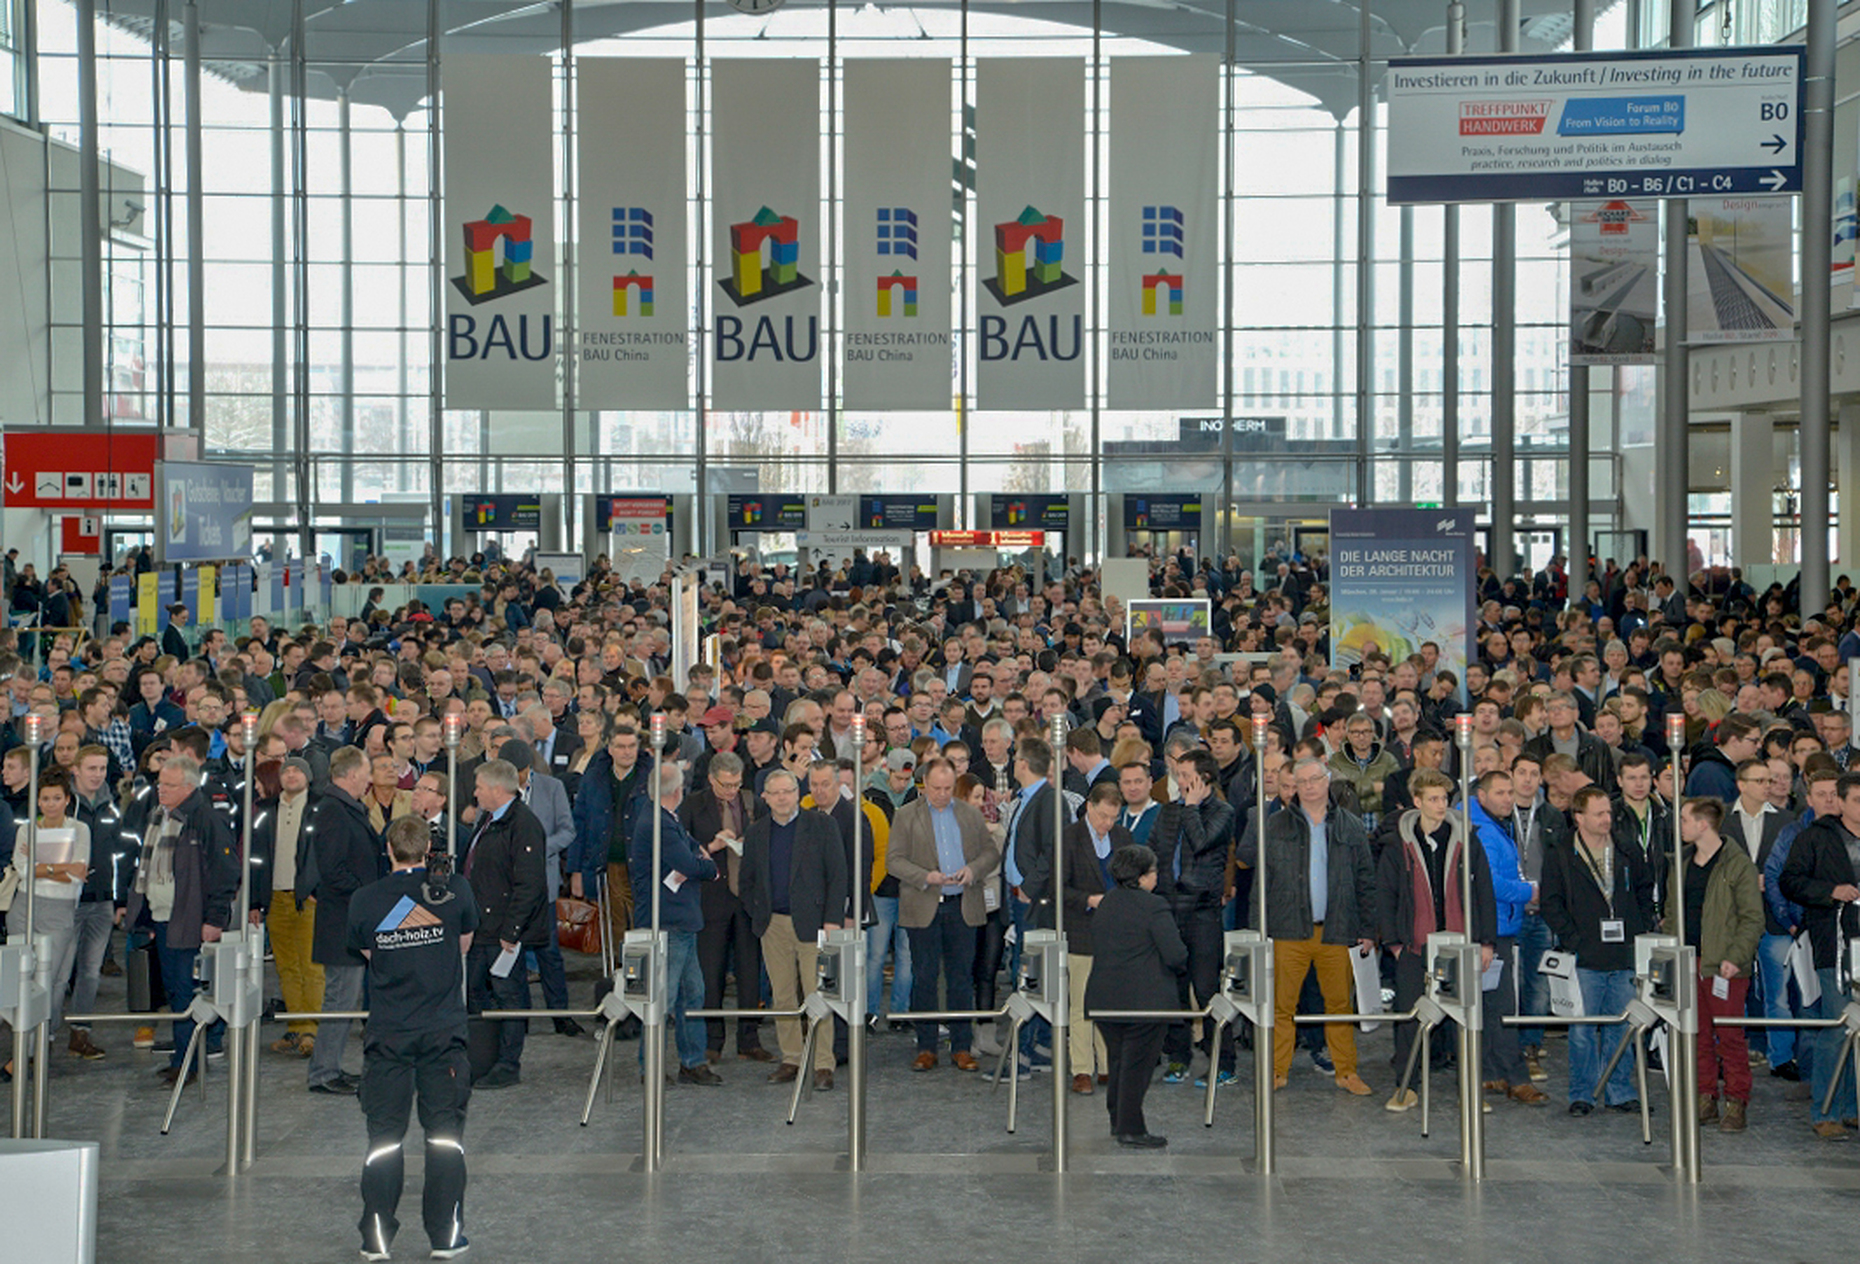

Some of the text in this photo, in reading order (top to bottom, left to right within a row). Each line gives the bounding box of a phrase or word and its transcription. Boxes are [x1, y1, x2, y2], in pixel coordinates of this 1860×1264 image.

[1395, 72, 1478, 88] Investieren
[1485, 71, 1498, 86] in
[1505, 70, 1528, 86] die
[1534, 68, 1596, 85] Zukunft
[1610, 66, 1681, 84] Investing
[1688, 65, 1702, 79] in
[1709, 64, 1735, 79] the
[1742, 62, 1792, 78] future
[1465, 103, 1546, 116] TREFFPUNKT
[1627, 102, 1660, 113] Forum
[1760, 102, 1788, 121] B0
[1463, 119, 1538, 133] HANDWERK
[1565, 115, 1678, 128] From Vision to Reality
[1462, 141, 1682, 157] Praxis, Forschung und Politik im Austausch
[1517, 159, 1560, 169] research
[1563, 157, 1583, 168] and
[1585, 156, 1622, 168] politics
[1625, 156, 1636, 166] in
[1639, 154, 1672, 166] dialog
[1607, 178, 1628, 193] B0
[1643, 177, 1663, 192] B6
[1665, 176, 1674, 193] /
[1676, 176, 1694, 191] C1
[1712, 175, 1732, 190] C4
[449, 314, 551, 361] BAU
[583, 332, 685, 345] FENESTRATION
[715, 315, 817, 362] BAU
[847, 332, 949, 345] FENESTRATION
[979, 314, 1082, 362] BAU
[1112, 330, 1214, 345] FENESTRATION
[583, 348, 650, 361] BAU China
[847, 348, 913, 361] BAU China
[1112, 347, 1178, 360] BAU China
[1200, 420, 1265, 431] INOHERM
[823, 534, 899, 543] Tourist Information
[1340, 549, 1455, 563] DIE LANGE NACHT
[1340, 564, 1455, 578] DER ARCHITEKTUR
[375, 927, 444, 943] dach-holz.tv
